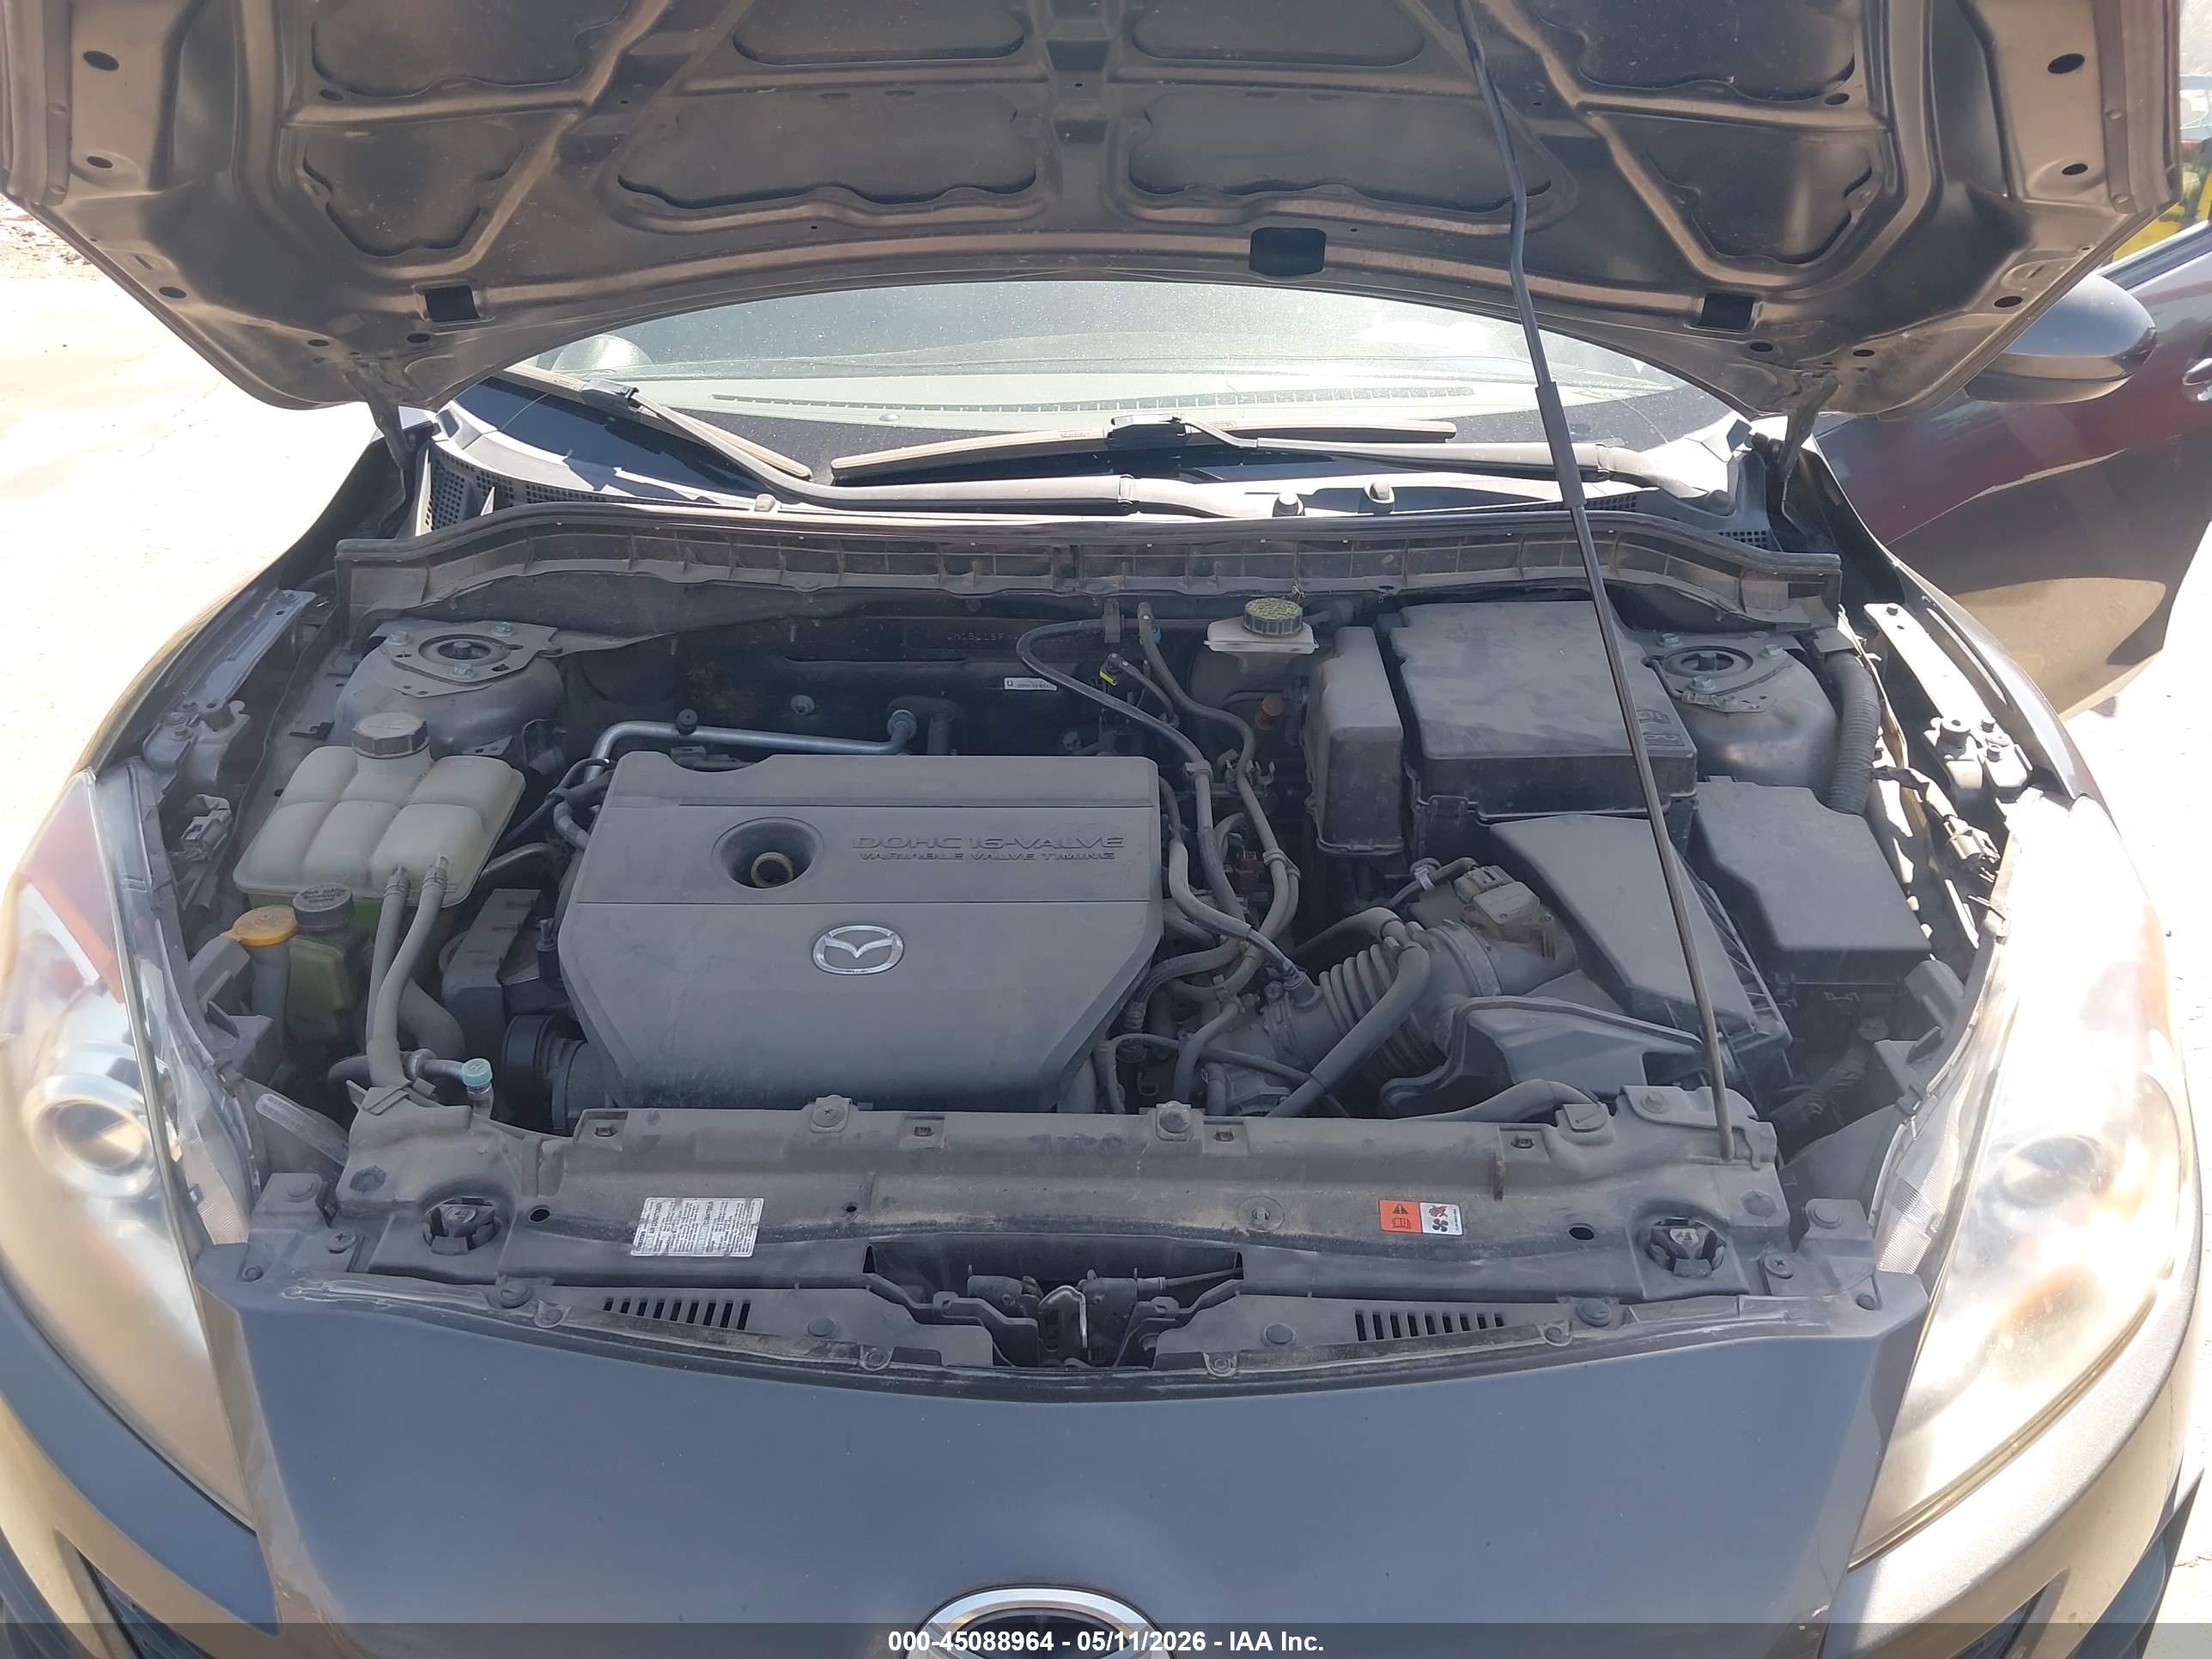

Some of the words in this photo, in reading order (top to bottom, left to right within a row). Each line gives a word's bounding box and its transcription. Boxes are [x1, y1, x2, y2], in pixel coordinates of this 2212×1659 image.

[852, 836, 963, 849] DOHC
[969, 836, 1124, 849] 16-VALVE
[859, 852, 963, 860] VARIABLE
[971, 852, 1036, 860] VALVE
[1042, 852, 1115, 860] TIMING
